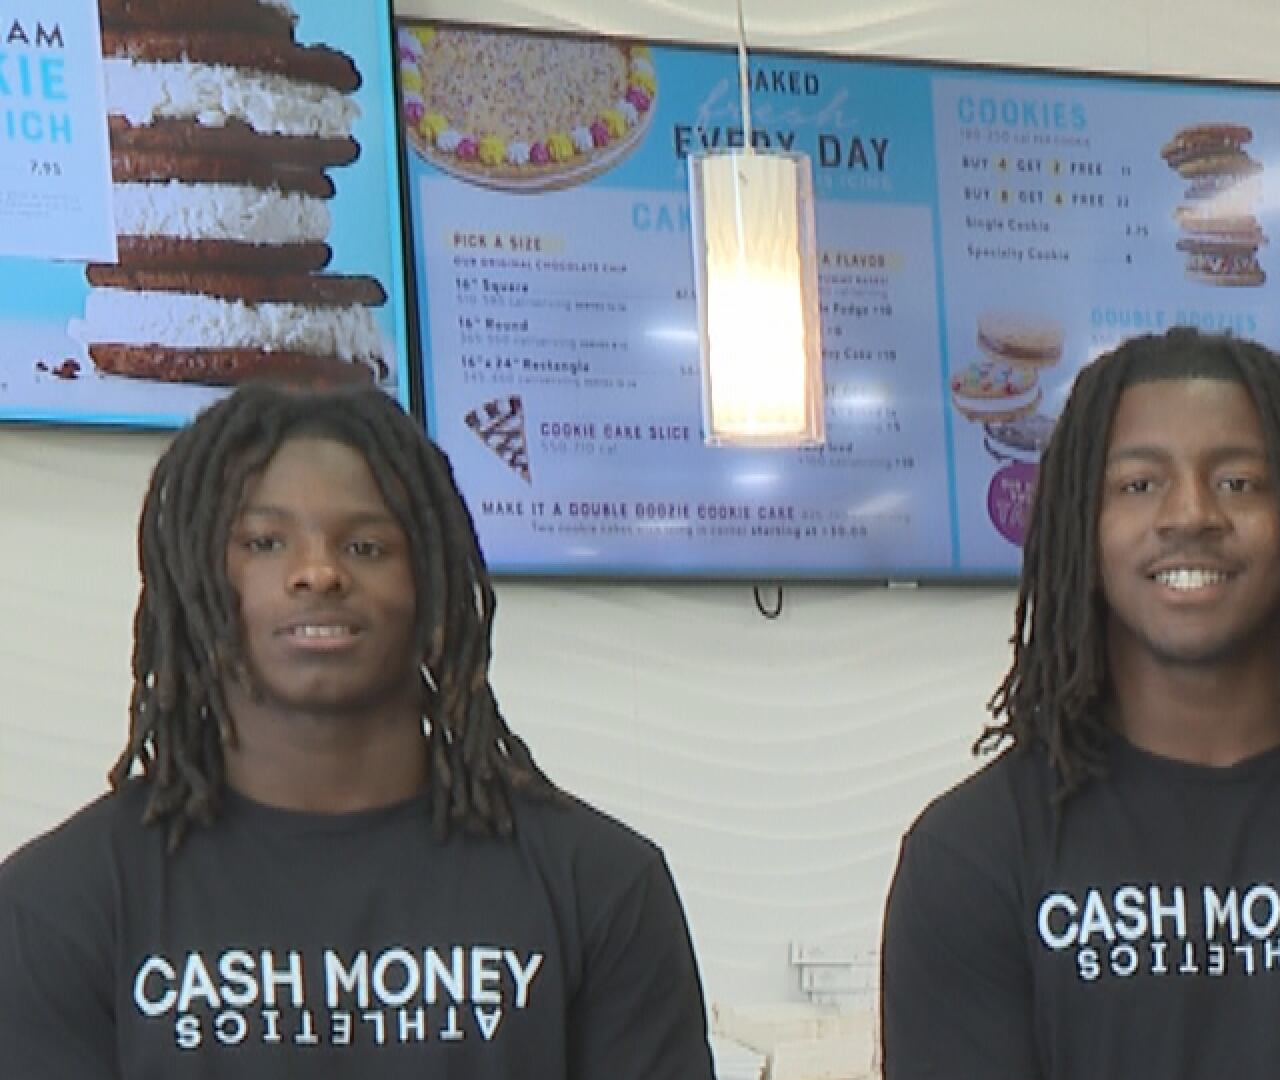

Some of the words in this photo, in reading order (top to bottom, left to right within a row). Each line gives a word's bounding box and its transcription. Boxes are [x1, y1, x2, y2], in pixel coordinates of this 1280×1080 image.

[0, 18, 65, 48] AM
[748, 67, 820, 97] AKED
[957, 96, 1088, 131] COOKIES
[817, 133, 889, 172] DAY
[962, 156, 988, 170] BUY
[1016, 158, 1041, 173] GET
[1070, 162, 1103, 176] FREE
[964, 187, 990, 201] BUY
[1018, 190, 1043, 204] GET
[1072, 194, 1104, 207] FREE
[1007, 219, 1050, 232] Cookie
[453, 232, 487, 248] PICK
[493, 233, 503, 249] A
[509, 234, 542, 251] SIZE
[836, 254, 886, 268] FLAVOR
[540, 421, 596, 439] COOKIE
[603, 423, 642, 441] CAKE
[649, 424, 690, 441] SLICE
[481, 500, 524, 517] MAKE
[531, 502, 545, 517] IT
[552, 502, 563, 517] A
[569, 502, 628, 519] DOUBLE
[635, 503, 690, 520] DOOZIE
[697, 504, 751, 521] COOKIE
[756, 505, 796, 521] CAKE
[1036, 883, 1188, 951] CASH
[132, 947, 306, 1017] CASH
[323, 944, 544, 1009] MONEY
[174, 1006, 504, 1051] ATHLETICS
